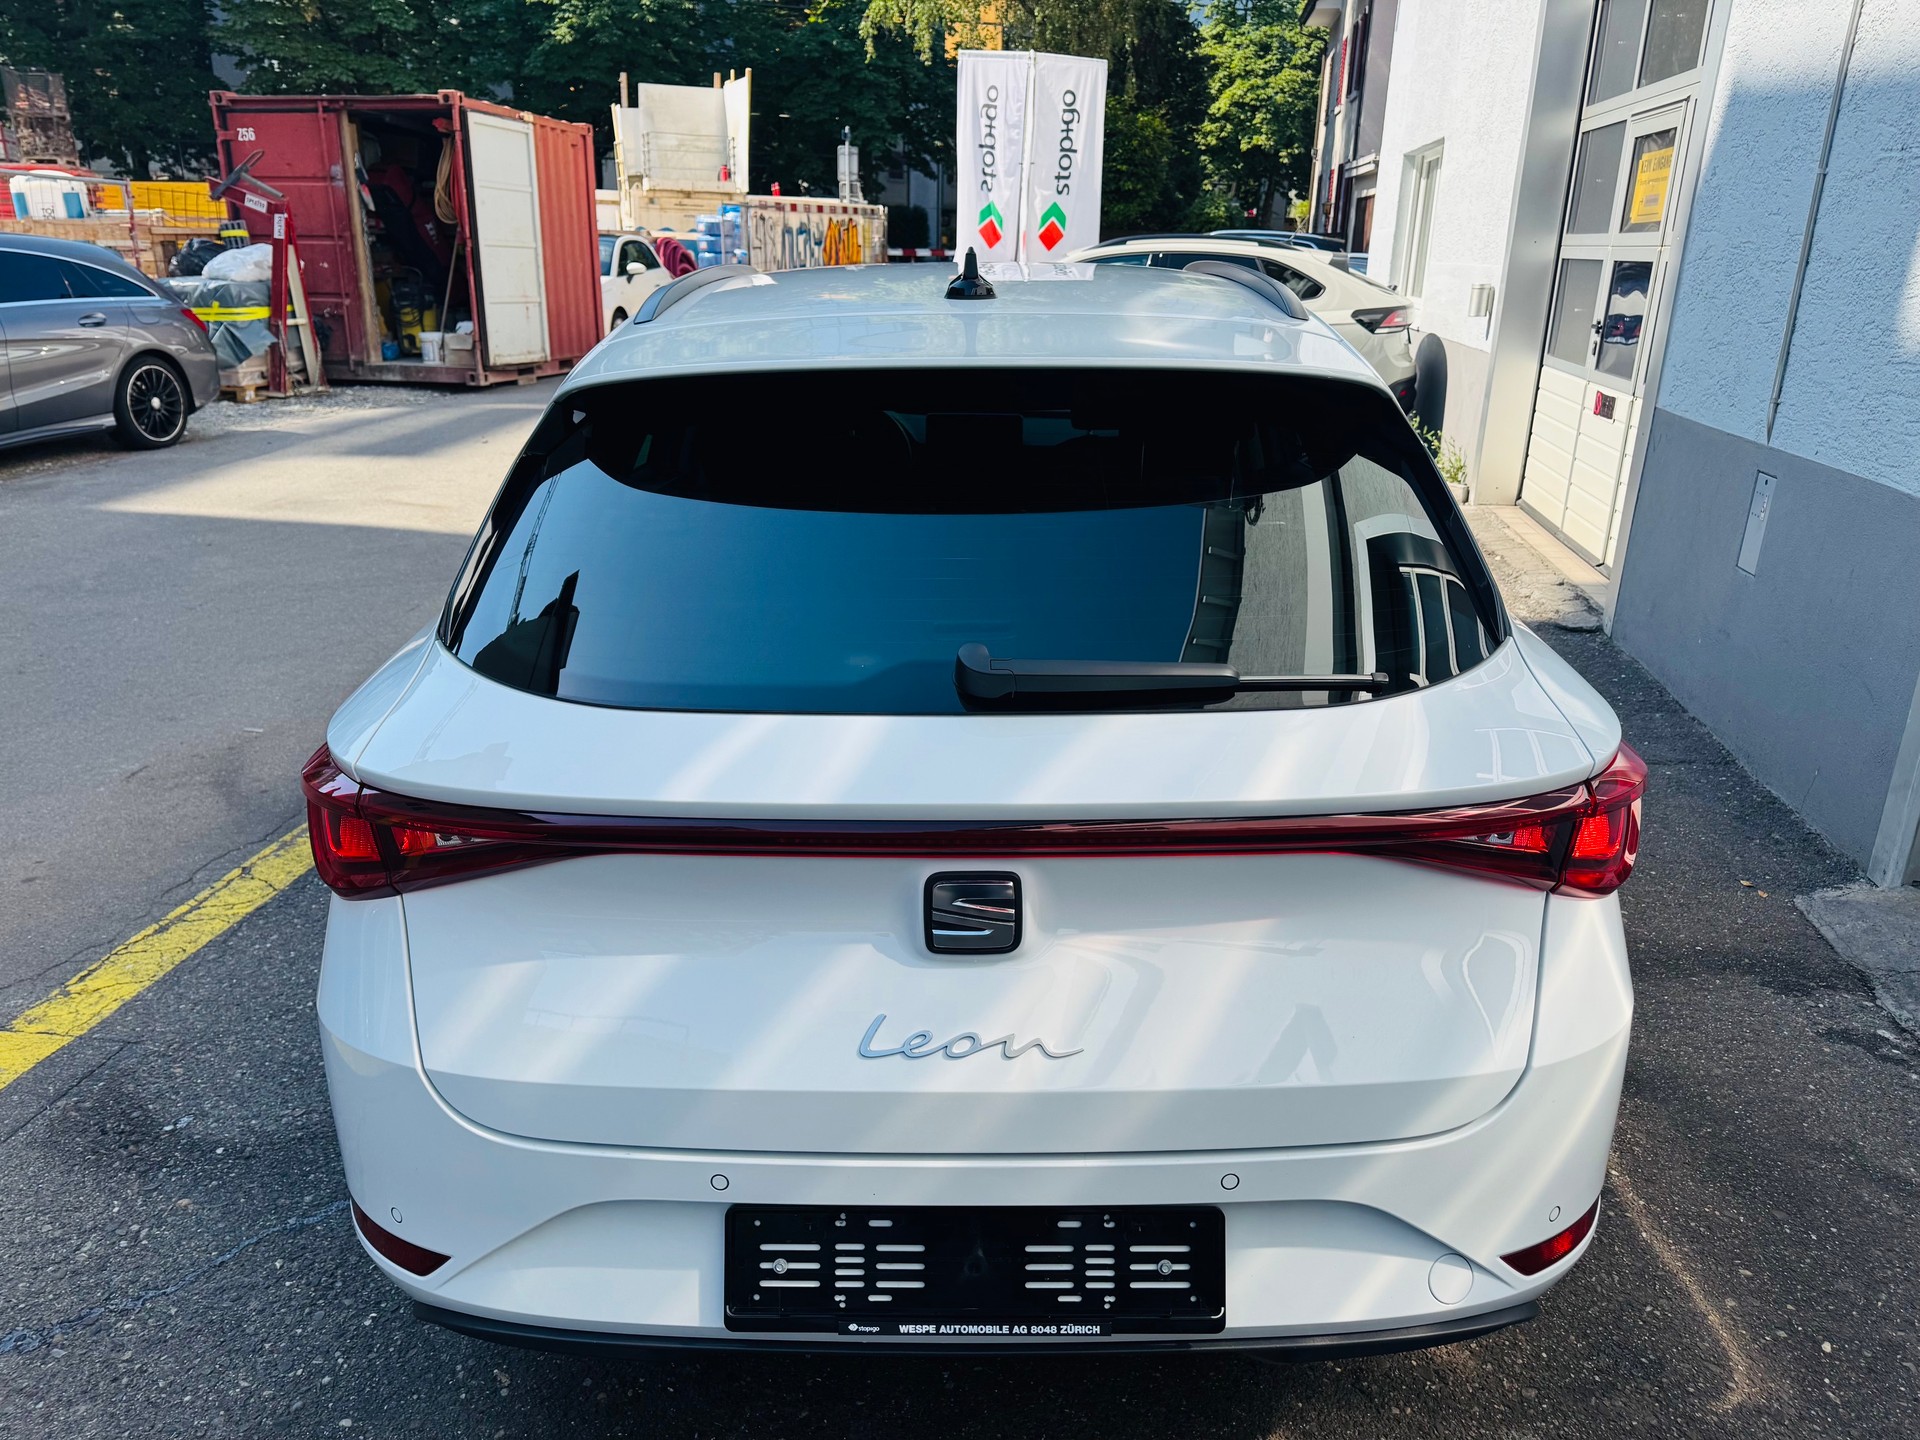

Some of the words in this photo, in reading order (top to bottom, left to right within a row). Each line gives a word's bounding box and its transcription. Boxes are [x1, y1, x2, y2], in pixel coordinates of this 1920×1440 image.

[1054, 89, 1081, 196] stop+go
[857, 1013, 1085, 1059] Leon
[898, 1324, 937, 1334] WESPE
[939, 1324, 1010, 1334] AUTOMOBILE
[1012, 1324, 1028, 1334] AG
[1030, 1324, 1057, 1334] 8048
[1060, 1323, 1100, 1334] ZÜRICH
